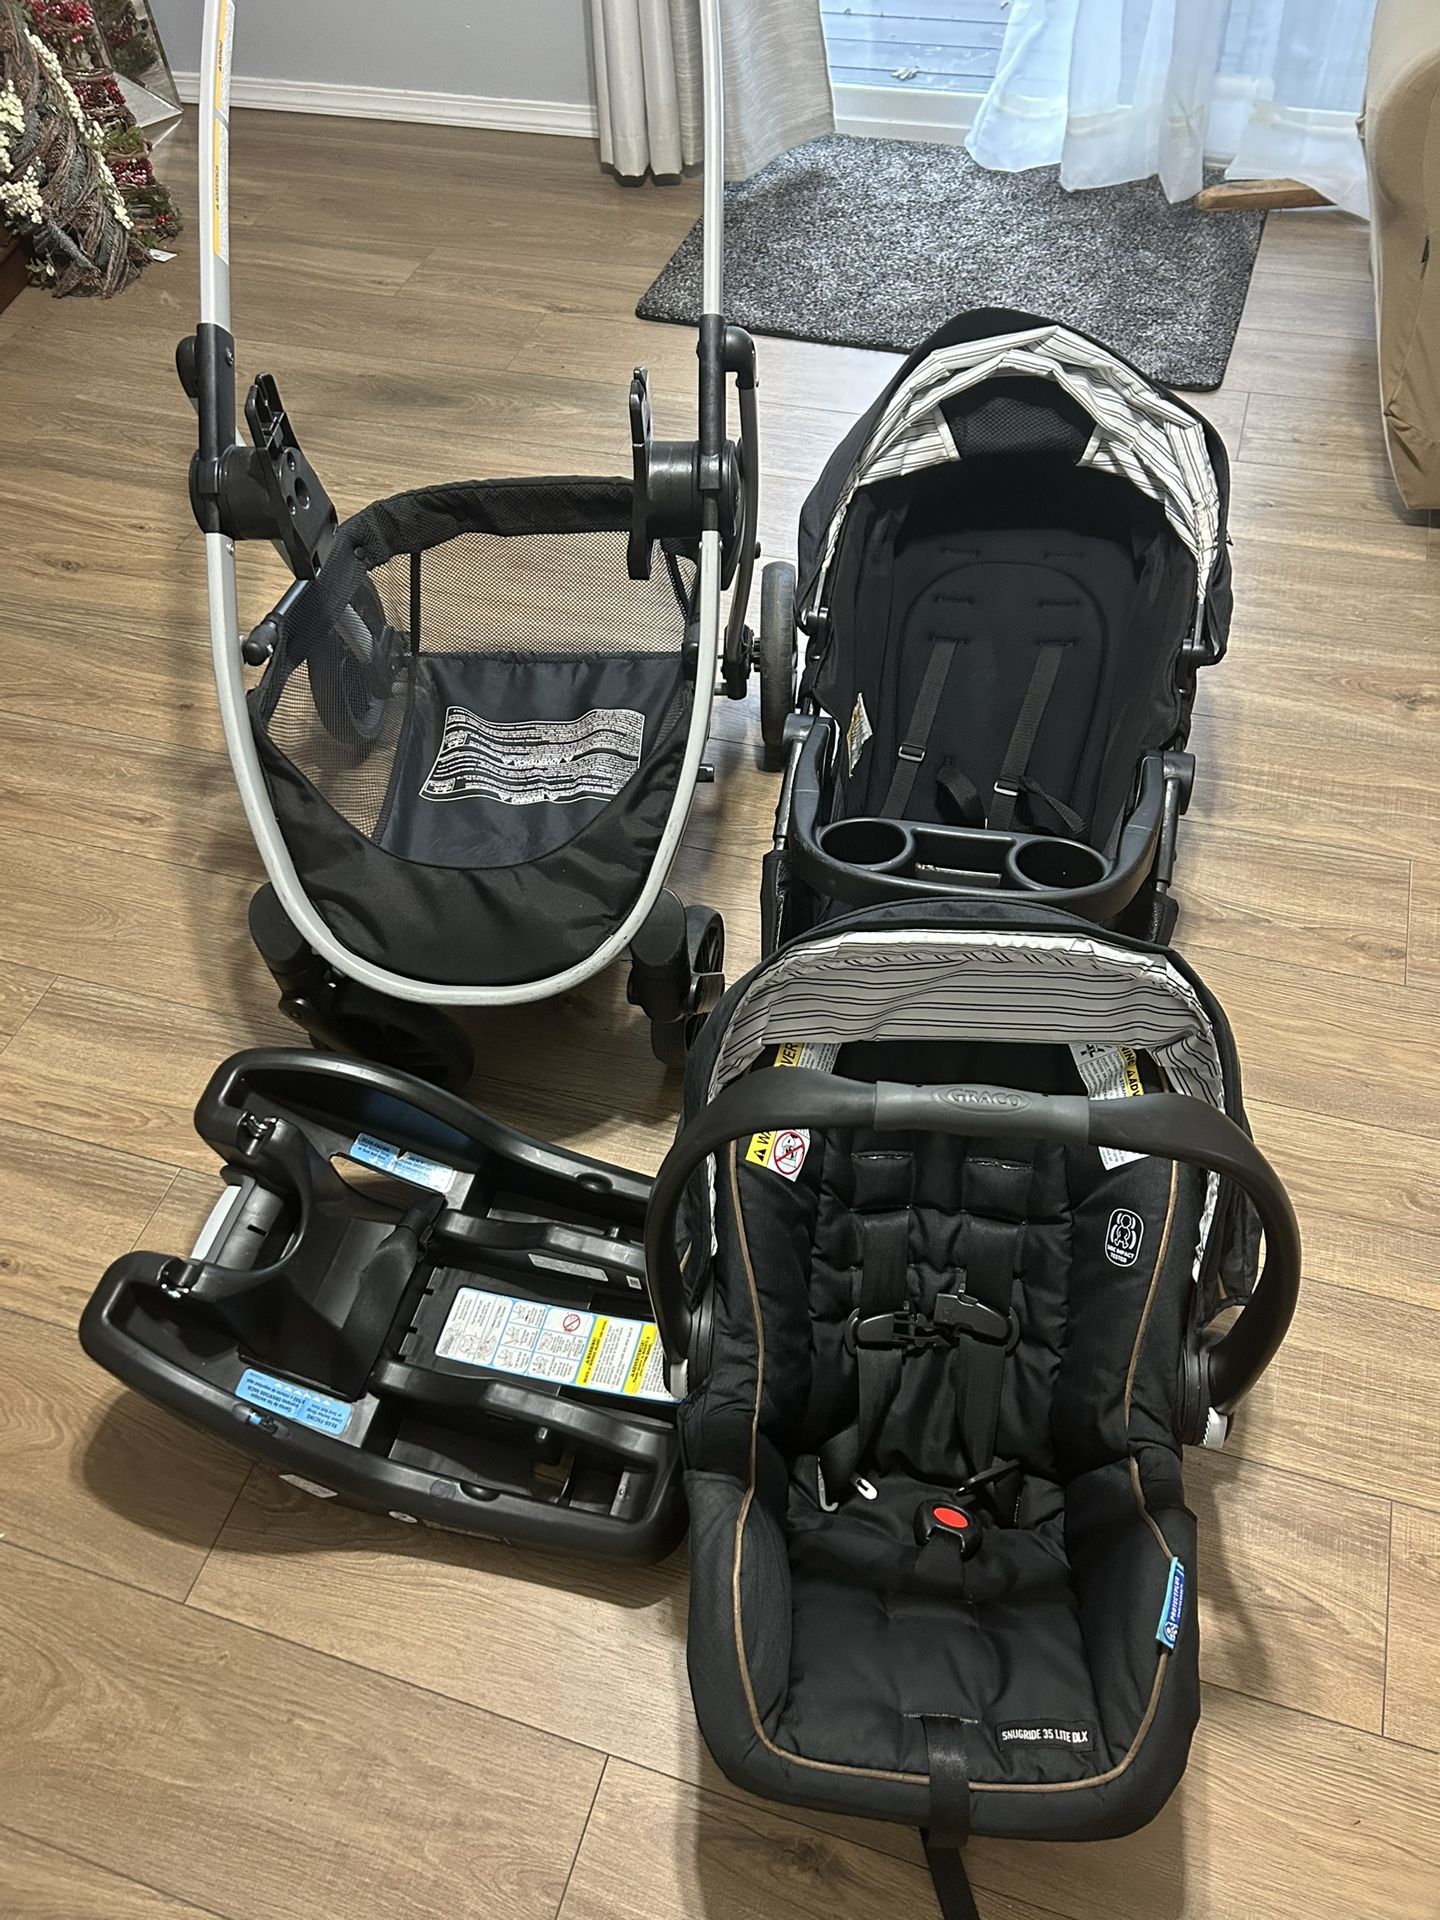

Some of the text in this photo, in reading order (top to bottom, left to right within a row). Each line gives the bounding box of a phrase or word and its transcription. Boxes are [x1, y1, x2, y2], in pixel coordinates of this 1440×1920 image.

[947, 1088, 1022, 1107] GRACO
[1110, 1252, 1127, 1263] TESTED
[1116, 1248, 1134, 1259] IMPACT
[1002, 1728, 1088, 1743] SNUGRIDE 35 LITE DLX
